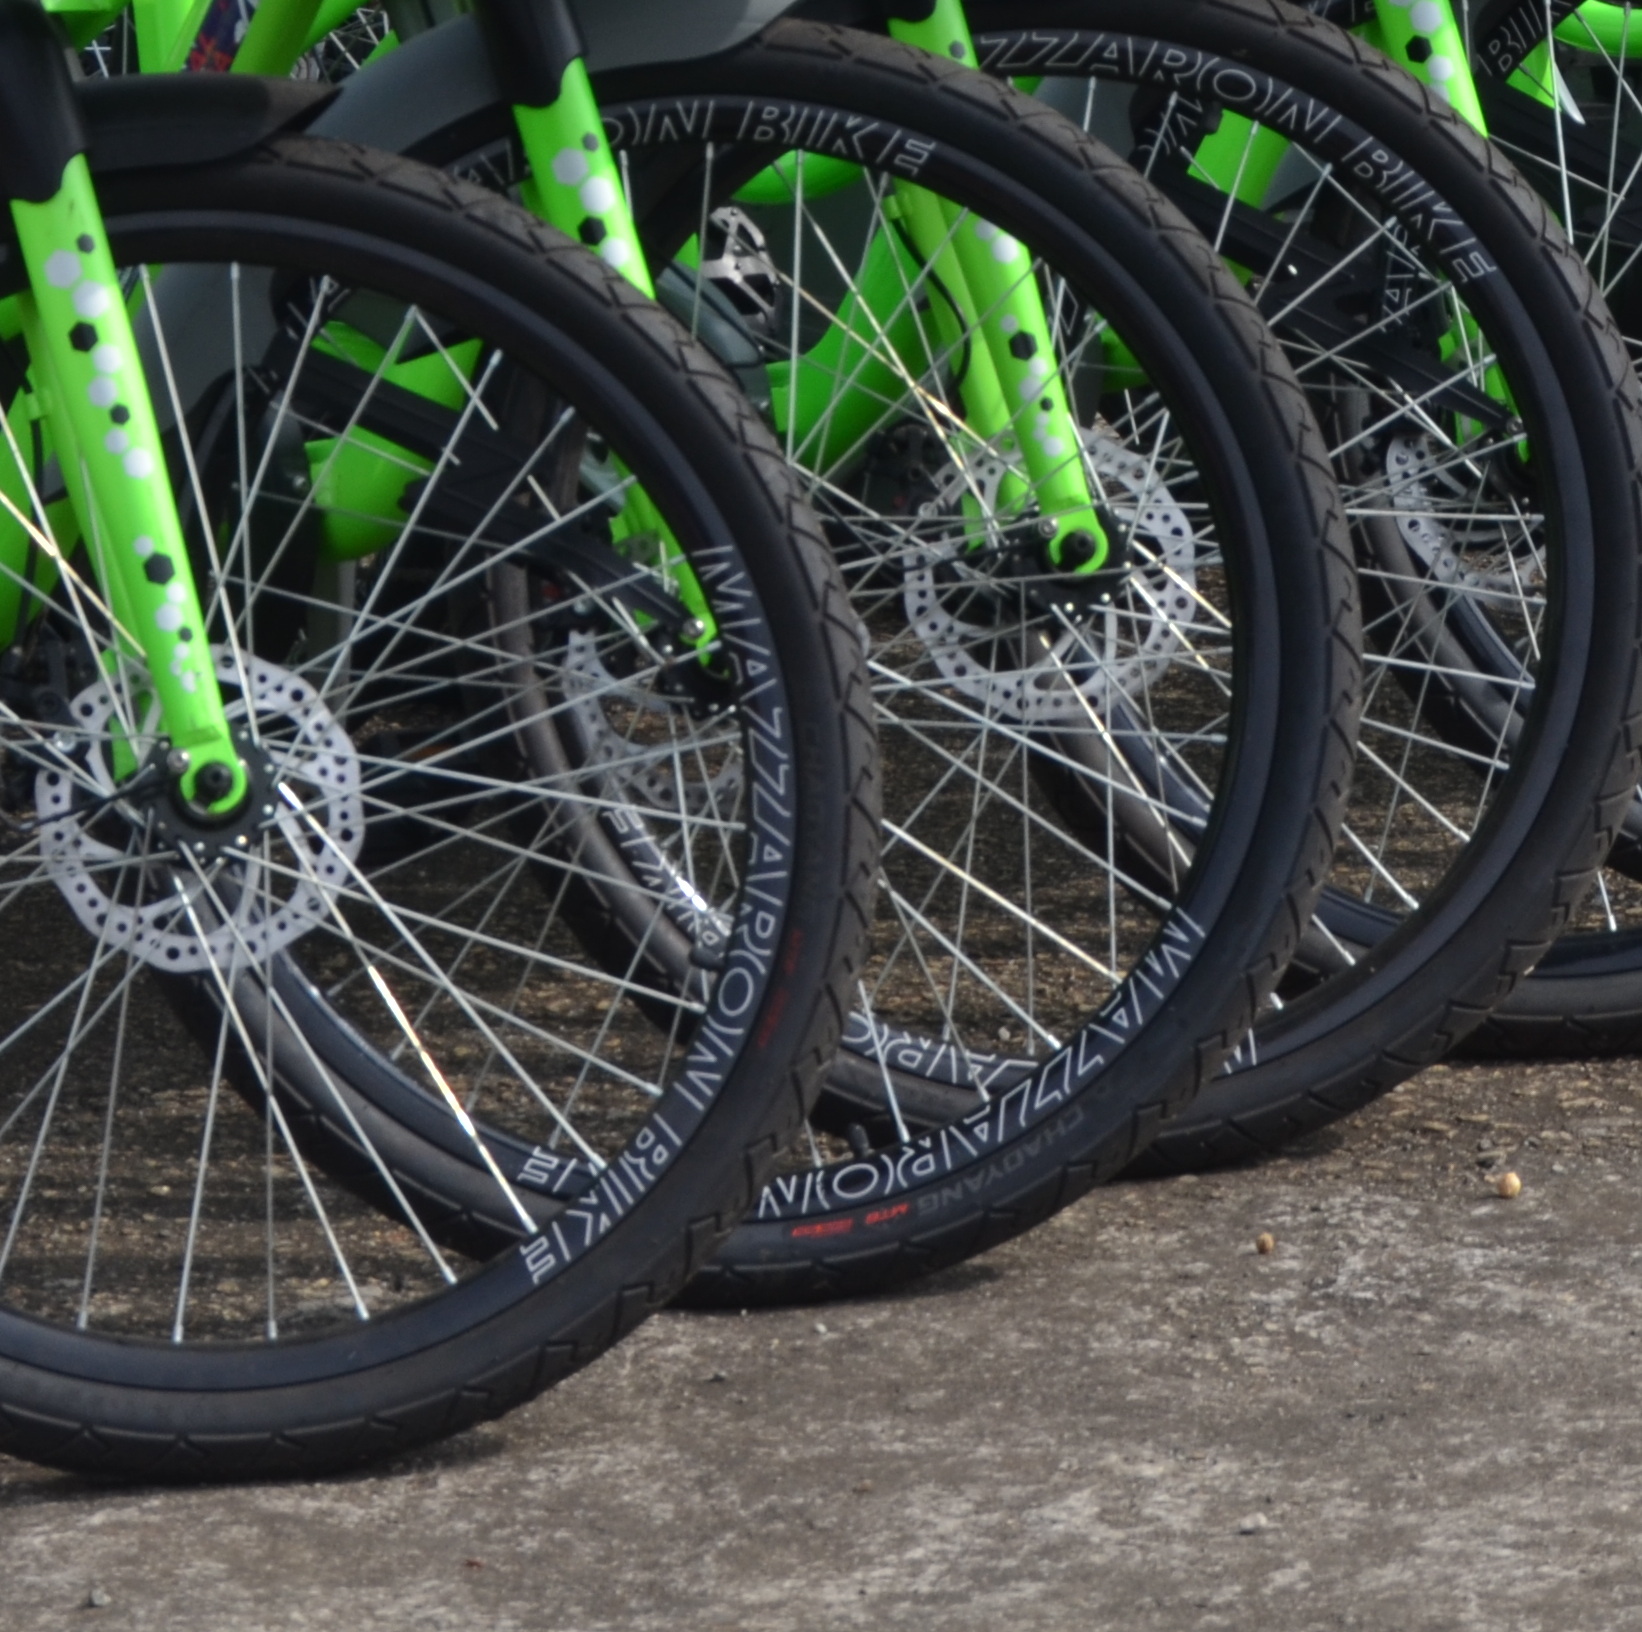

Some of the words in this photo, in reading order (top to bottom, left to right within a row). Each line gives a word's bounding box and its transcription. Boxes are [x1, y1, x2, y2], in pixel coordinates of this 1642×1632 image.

[737, 99, 938, 177] BIKE
[1341, 134, 1500, 286] BIKE
[674, 544, 793, 1113] MAZZARON
[519, 1112, 683, 1286] BIKE
